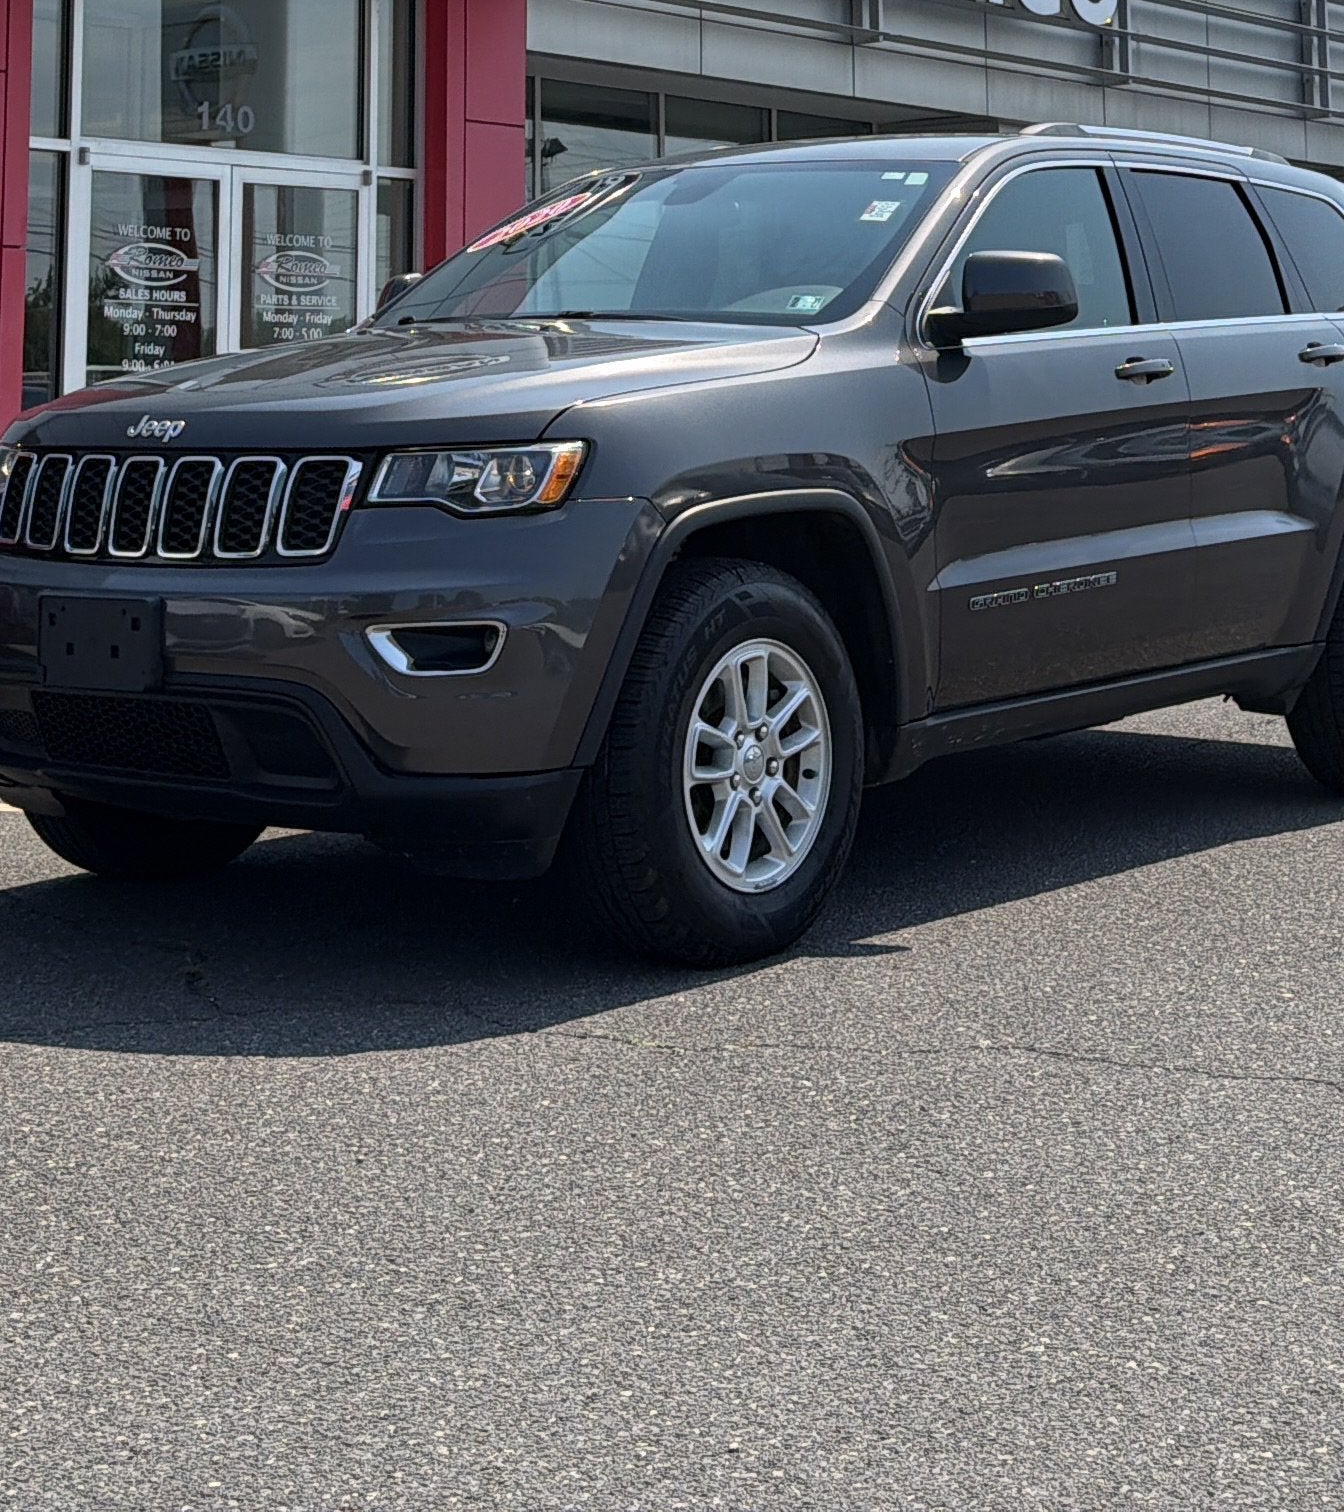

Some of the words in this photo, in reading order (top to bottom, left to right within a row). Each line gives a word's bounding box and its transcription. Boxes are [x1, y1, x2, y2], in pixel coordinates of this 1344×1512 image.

[197, 101, 255, 133] 140
[117, 224, 172, 240] WELCOME
[174, 228, 191, 241] TO
[266, 234, 316, 247] WELCOME
[317, 236, 333, 248] TO
[127, 246, 185, 268] Romeo
[275, 254, 328, 275] Romeo
[131, 268, 174, 279] NISSAN
[279, 276, 318, 284] NISSAN
[119, 288, 150, 300] SALES
[152, 289, 187, 302] HOURS
[261, 294, 290, 305] PARTS
[291, 295, 298, 305] &
[300, 295, 337, 306] SERVICE
[104, 305, 144, 321] Monday
[151, 308, 197, 324] Thursday
[263, 311, 299, 326] Monday
[305, 312, 333, 326] Friday
[123, 323, 146, 336] 9:00
[154, 324, 177, 337] 7:00
[273, 327, 294, 339] 7:00
[134, 342, 166, 357] Friday
[127, 414, 186, 442] Jeep
[970, 588, 1030, 611] GRAND
[1033, 571, 1118, 599] CHEROKEE
